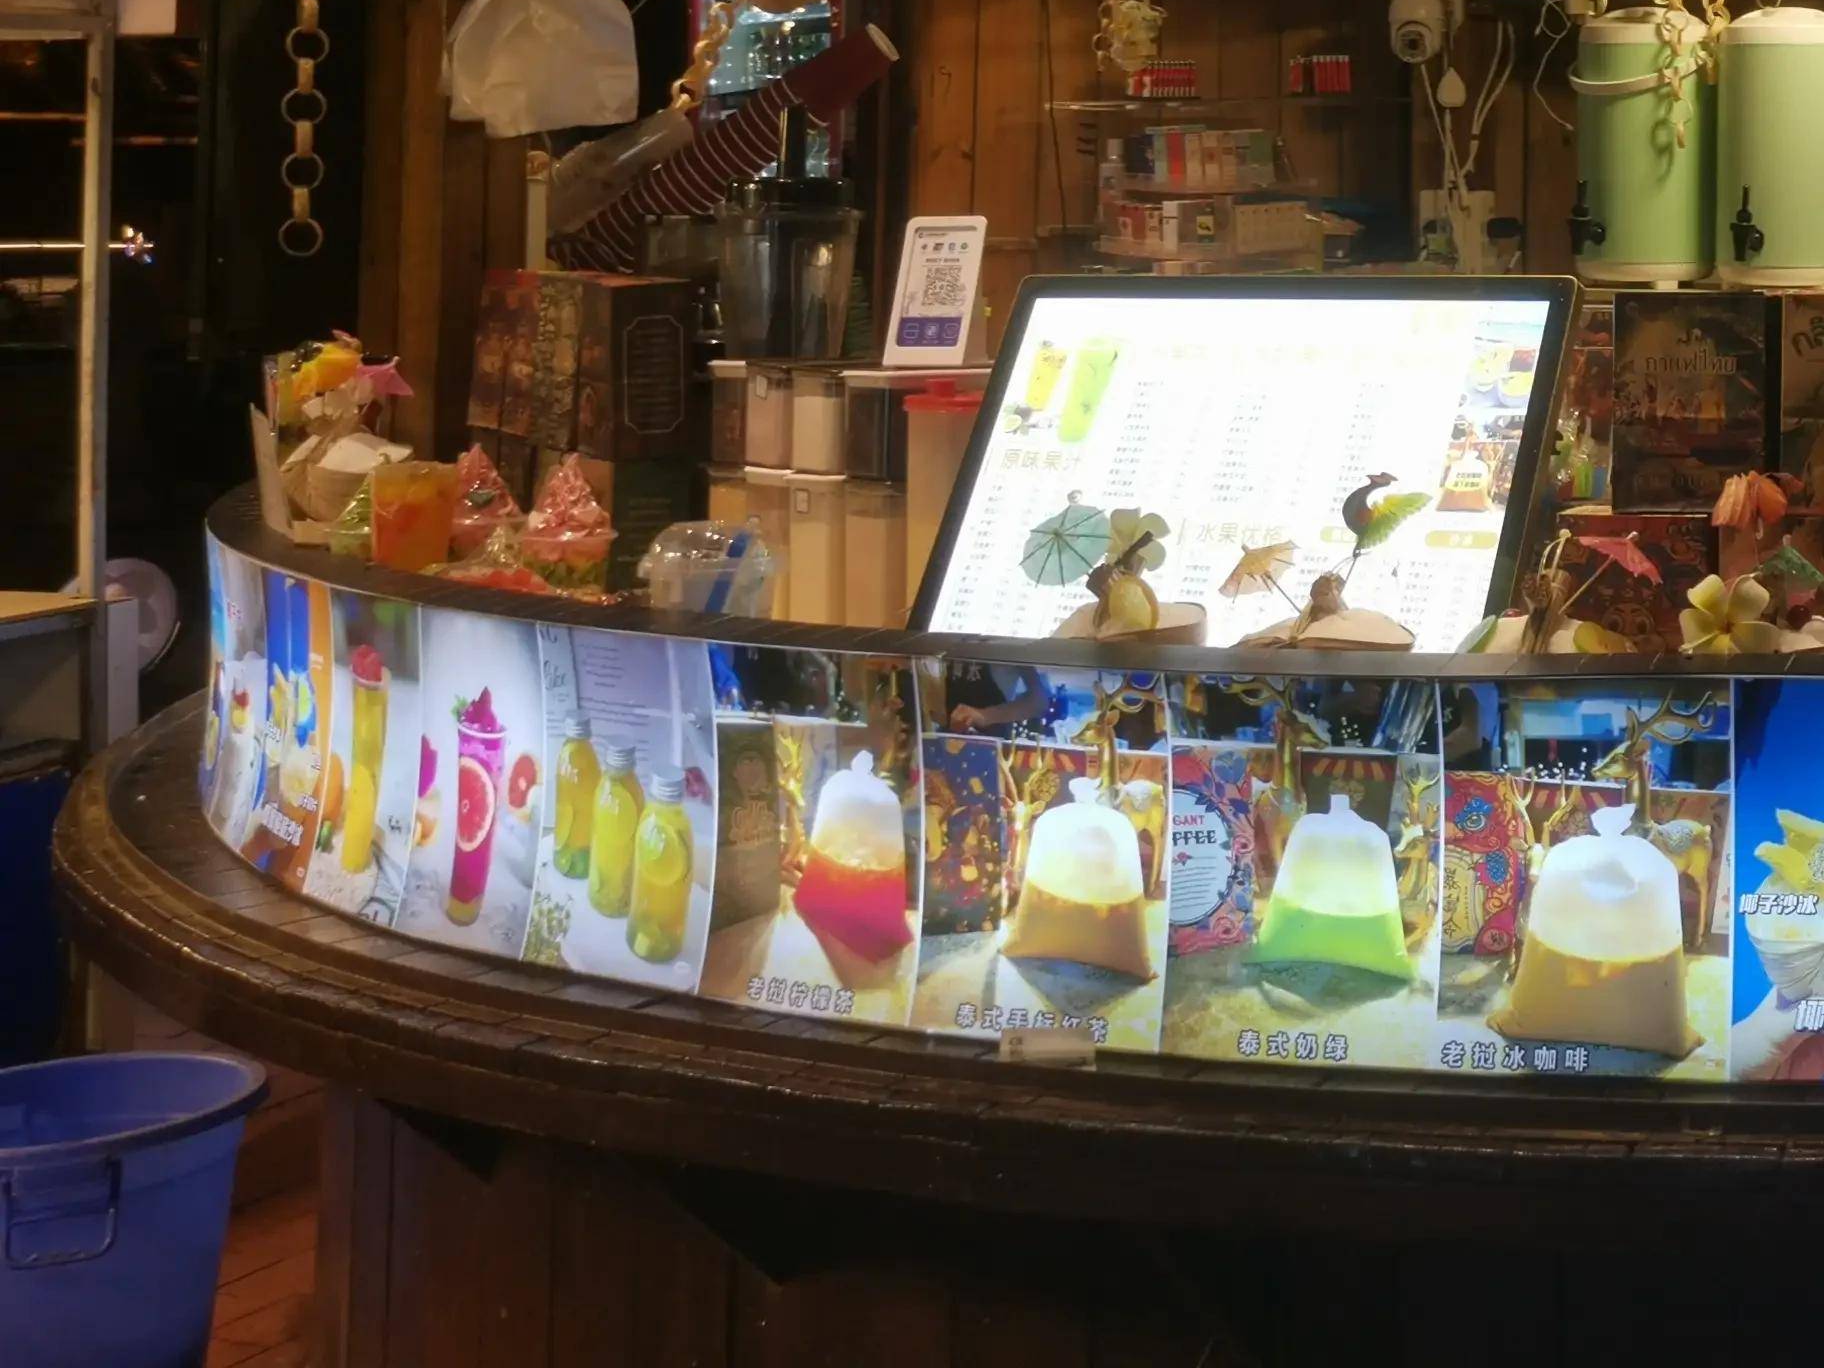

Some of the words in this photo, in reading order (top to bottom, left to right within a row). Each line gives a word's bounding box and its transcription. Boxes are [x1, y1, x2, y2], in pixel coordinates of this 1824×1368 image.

[1738, 893, 1819, 916] 椰子沙冰
[1237, 1028, 1349, 1063] 泰式奶绿
[1440, 1039, 1590, 1073] 老挝冰咖啡
